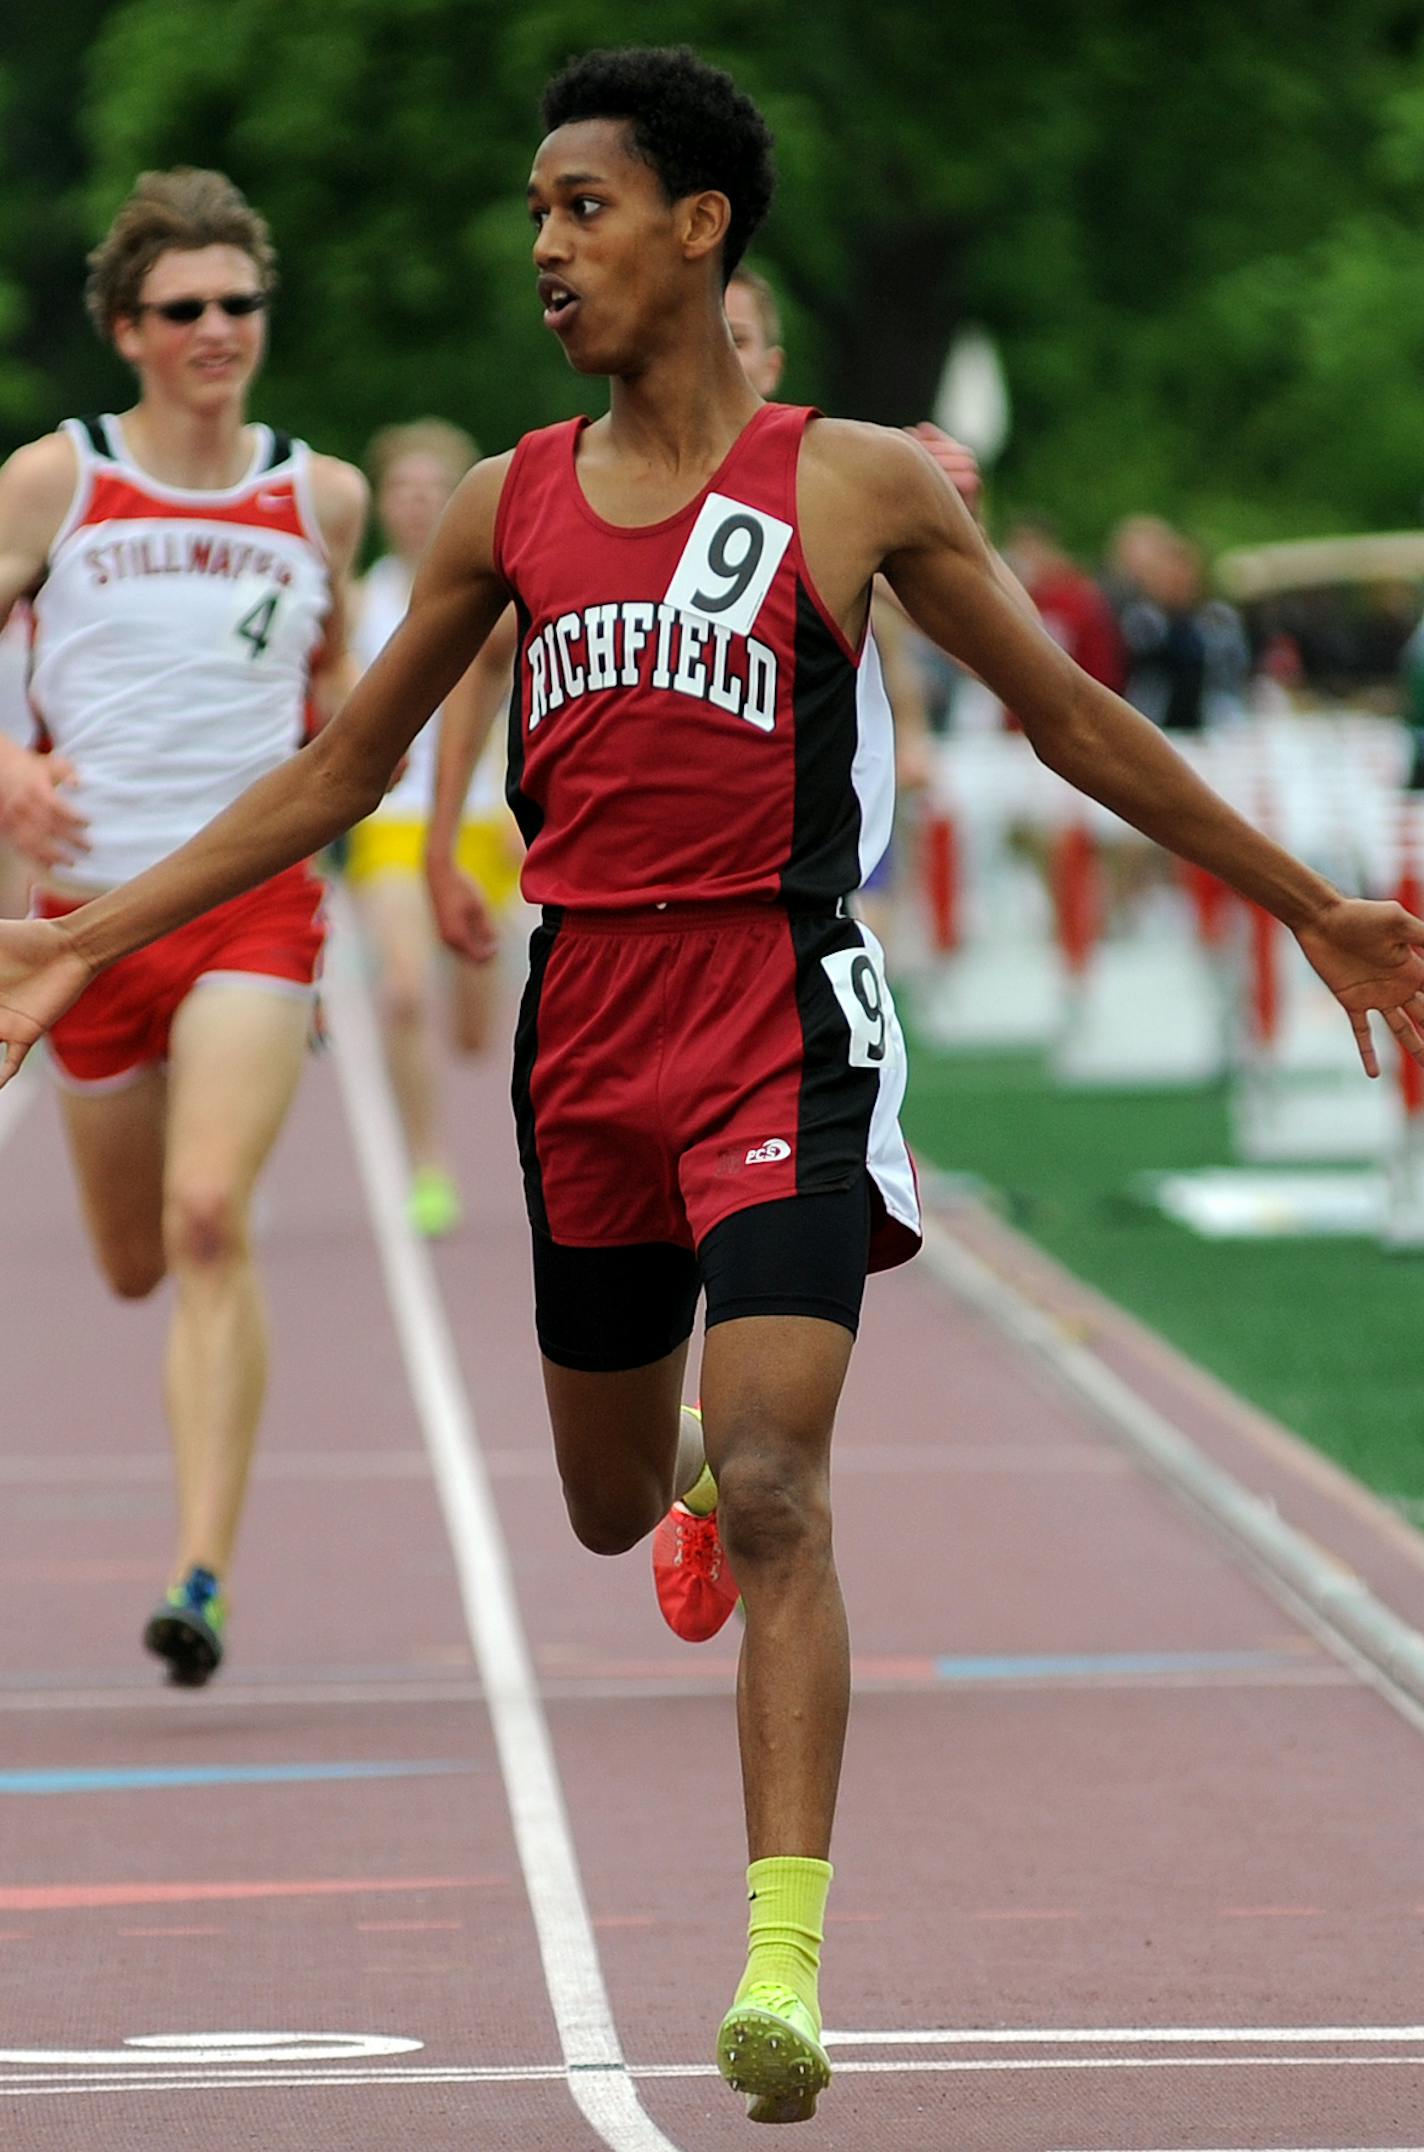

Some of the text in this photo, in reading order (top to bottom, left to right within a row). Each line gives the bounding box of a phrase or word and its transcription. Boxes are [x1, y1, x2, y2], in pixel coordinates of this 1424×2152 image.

[689, 513, 765, 613] 9
[237, 592, 279, 660] 4
[527, 602, 777, 734] RICHFIELD
[851, 955, 886, 1062] 9
